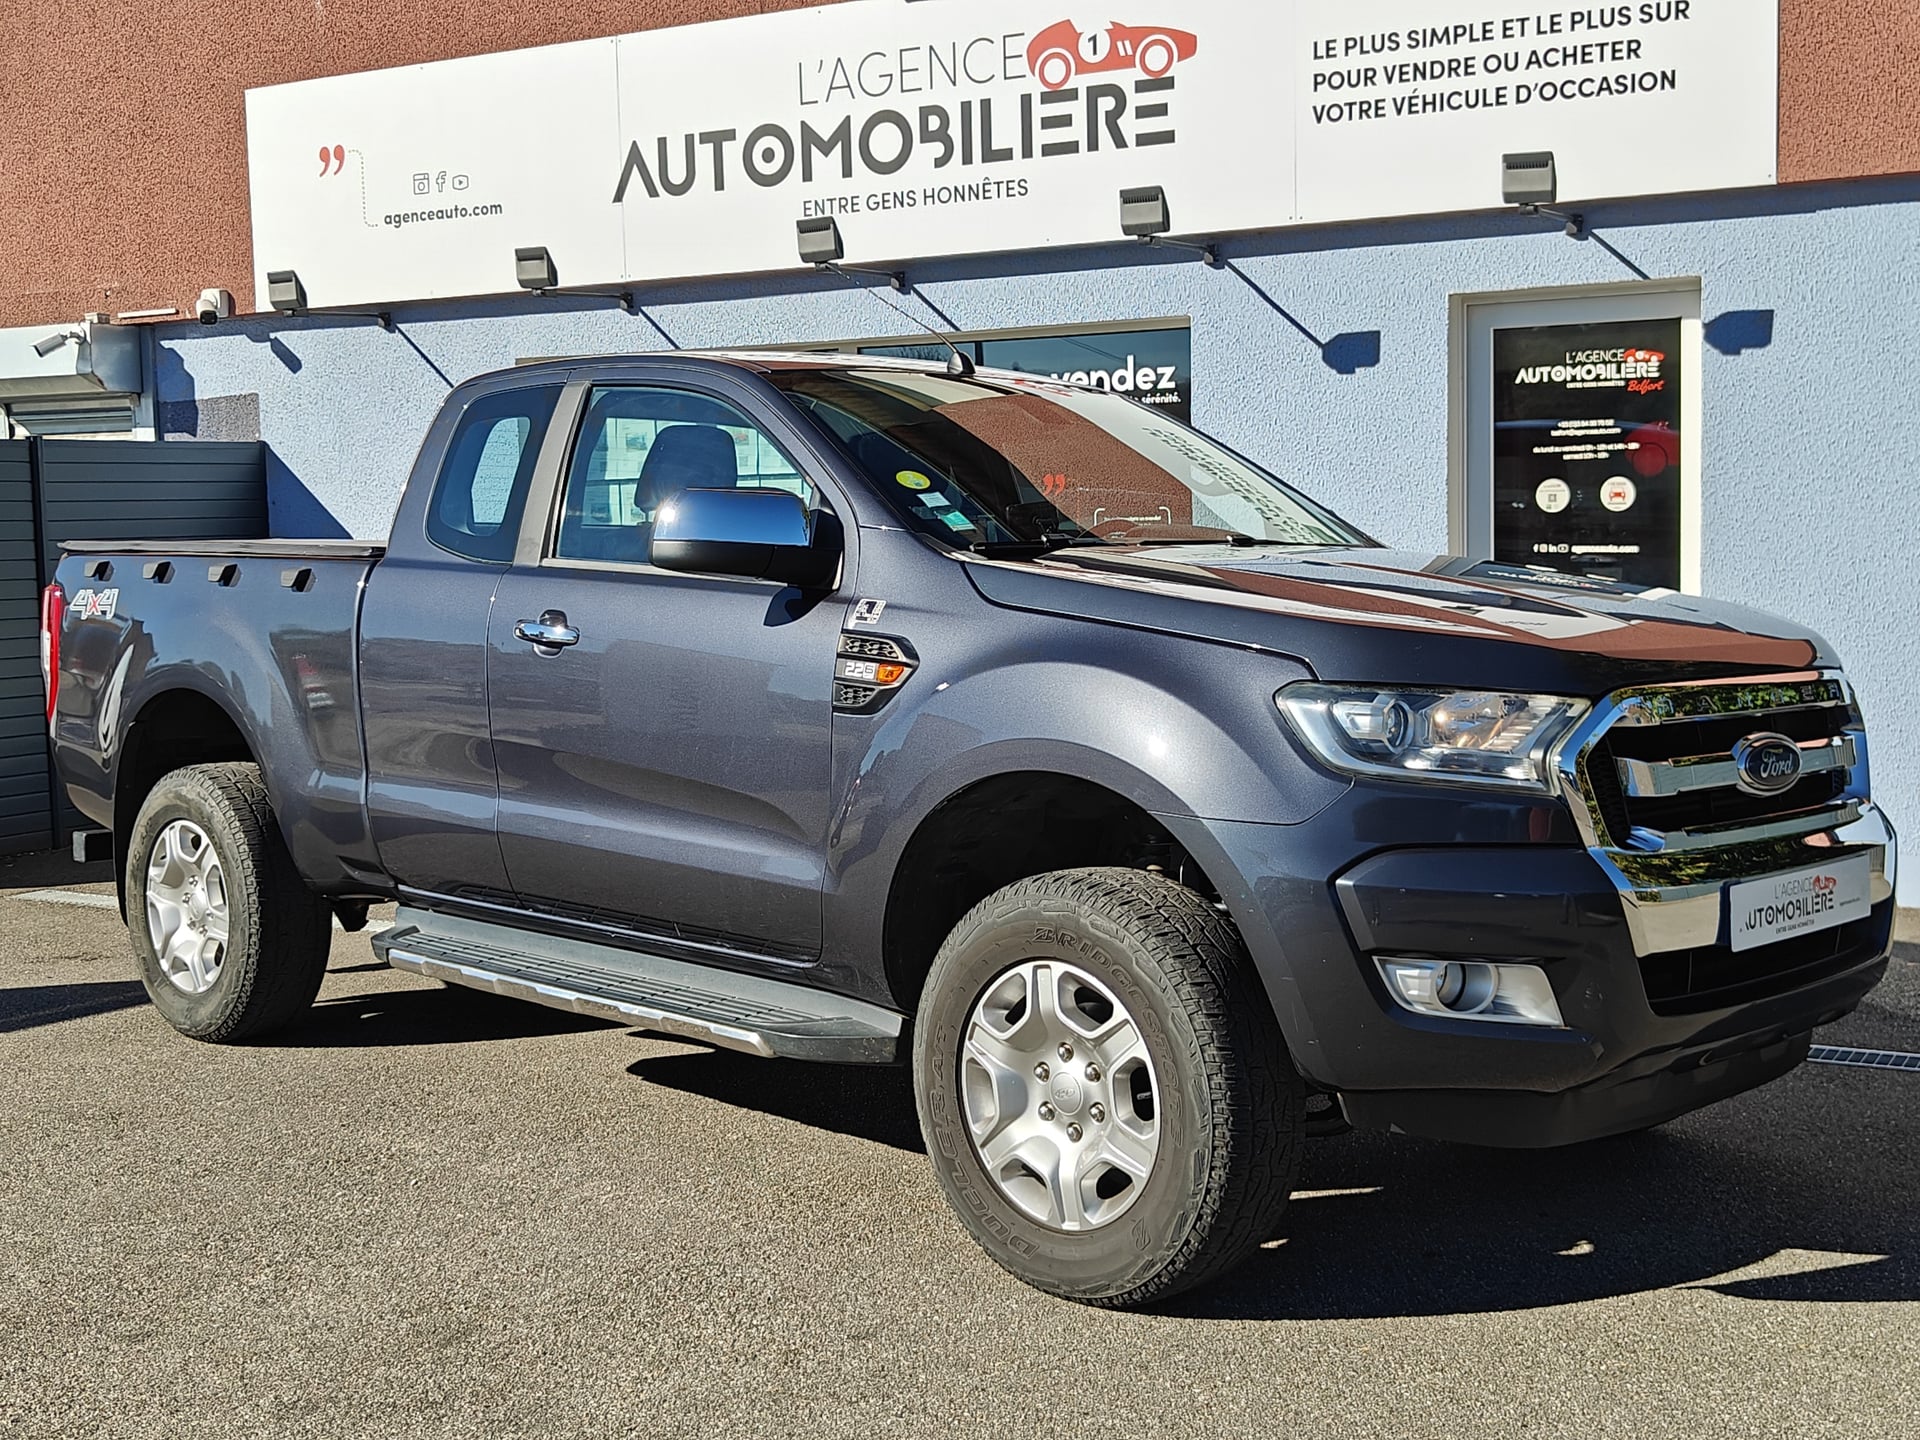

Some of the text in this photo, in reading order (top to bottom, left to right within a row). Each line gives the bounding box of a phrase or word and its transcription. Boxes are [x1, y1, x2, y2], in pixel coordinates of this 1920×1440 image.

[1313, 39, 1337, 60] LE
[1344, 32, 1400, 57] PLUS
[1407, 21, 1494, 50] SIMPLE
[1502, 17, 1530, 39] ET
[1537, 13, 1562, 35] LE
[1570, 6, 1632, 31] PLUS
[799, 33, 1026, 105] L'AGENCE
[1313, 39, 1641, 92] POUR VENDRE OU ACHETER
[1312, 70, 1676, 124] VOTRE VÉHICULE D'OCCASION
[384, 204, 502, 228] agenceauto.com
[803, 177, 1028, 217] ENTRE GENS HONNÊTES
[1759, 748, 1794, 779] Ford
